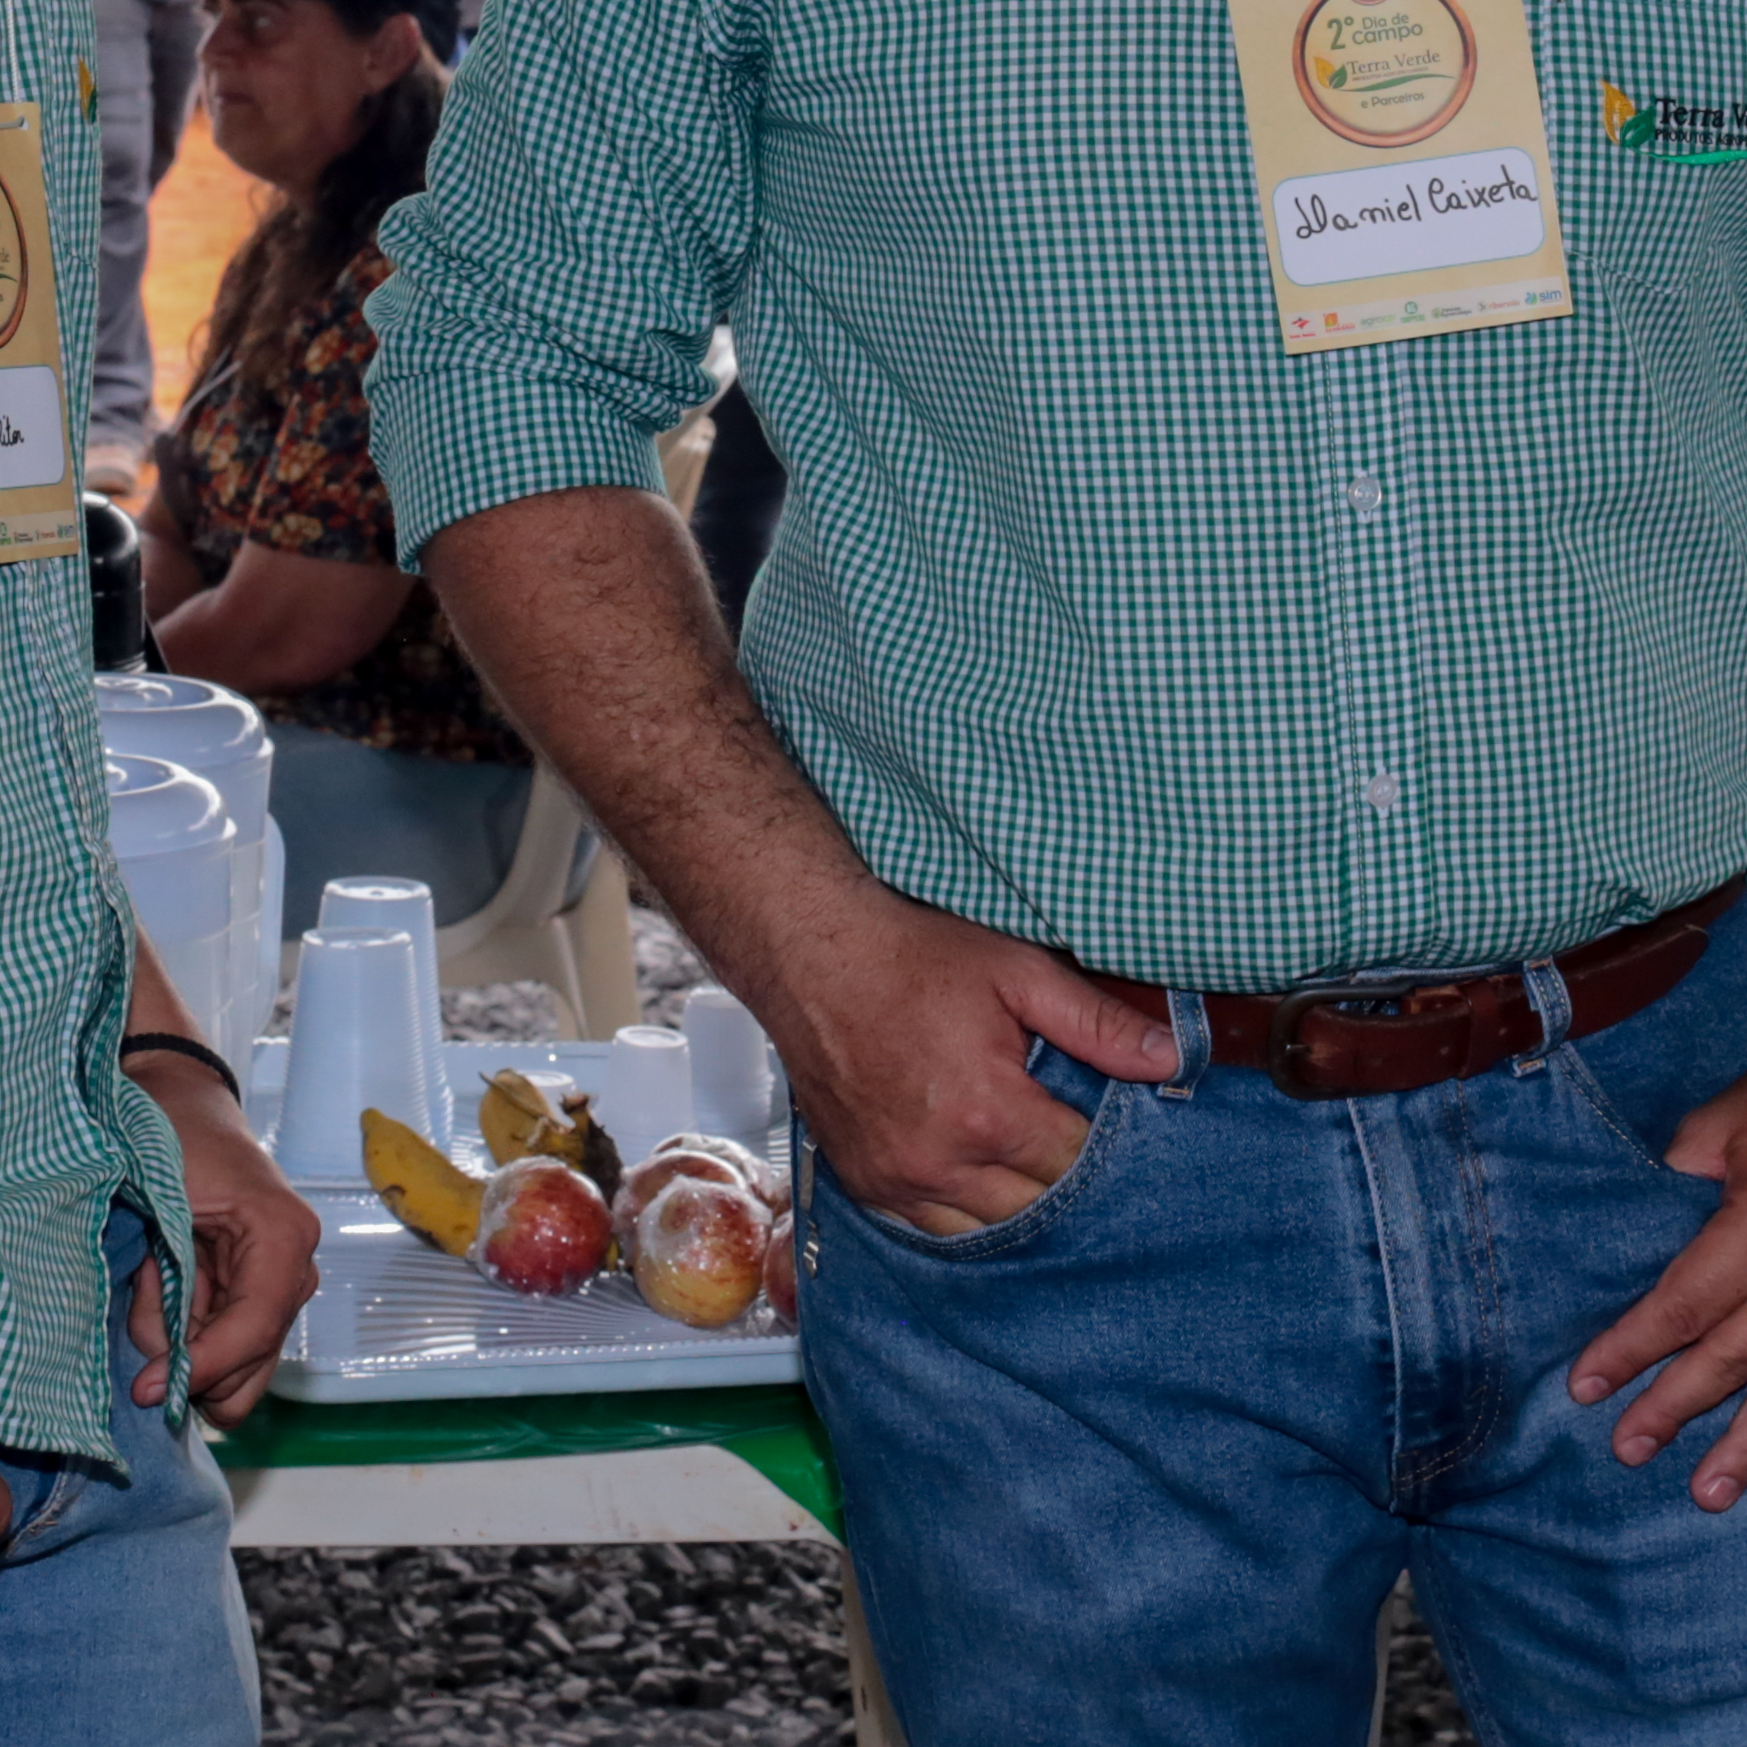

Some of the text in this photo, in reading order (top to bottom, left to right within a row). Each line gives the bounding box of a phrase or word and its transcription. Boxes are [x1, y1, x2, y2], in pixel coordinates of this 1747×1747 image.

[1362, 16, 1387, 30] Dia
[1391, 13, 1410, 26] de
[1347, 49, 1440, 75] Terra Verde
[1361, 92, 1425, 109] e Parceiros
[1655, 98, 1724, 128] Terra
[1428, 164, 1538, 214] Caixeta
